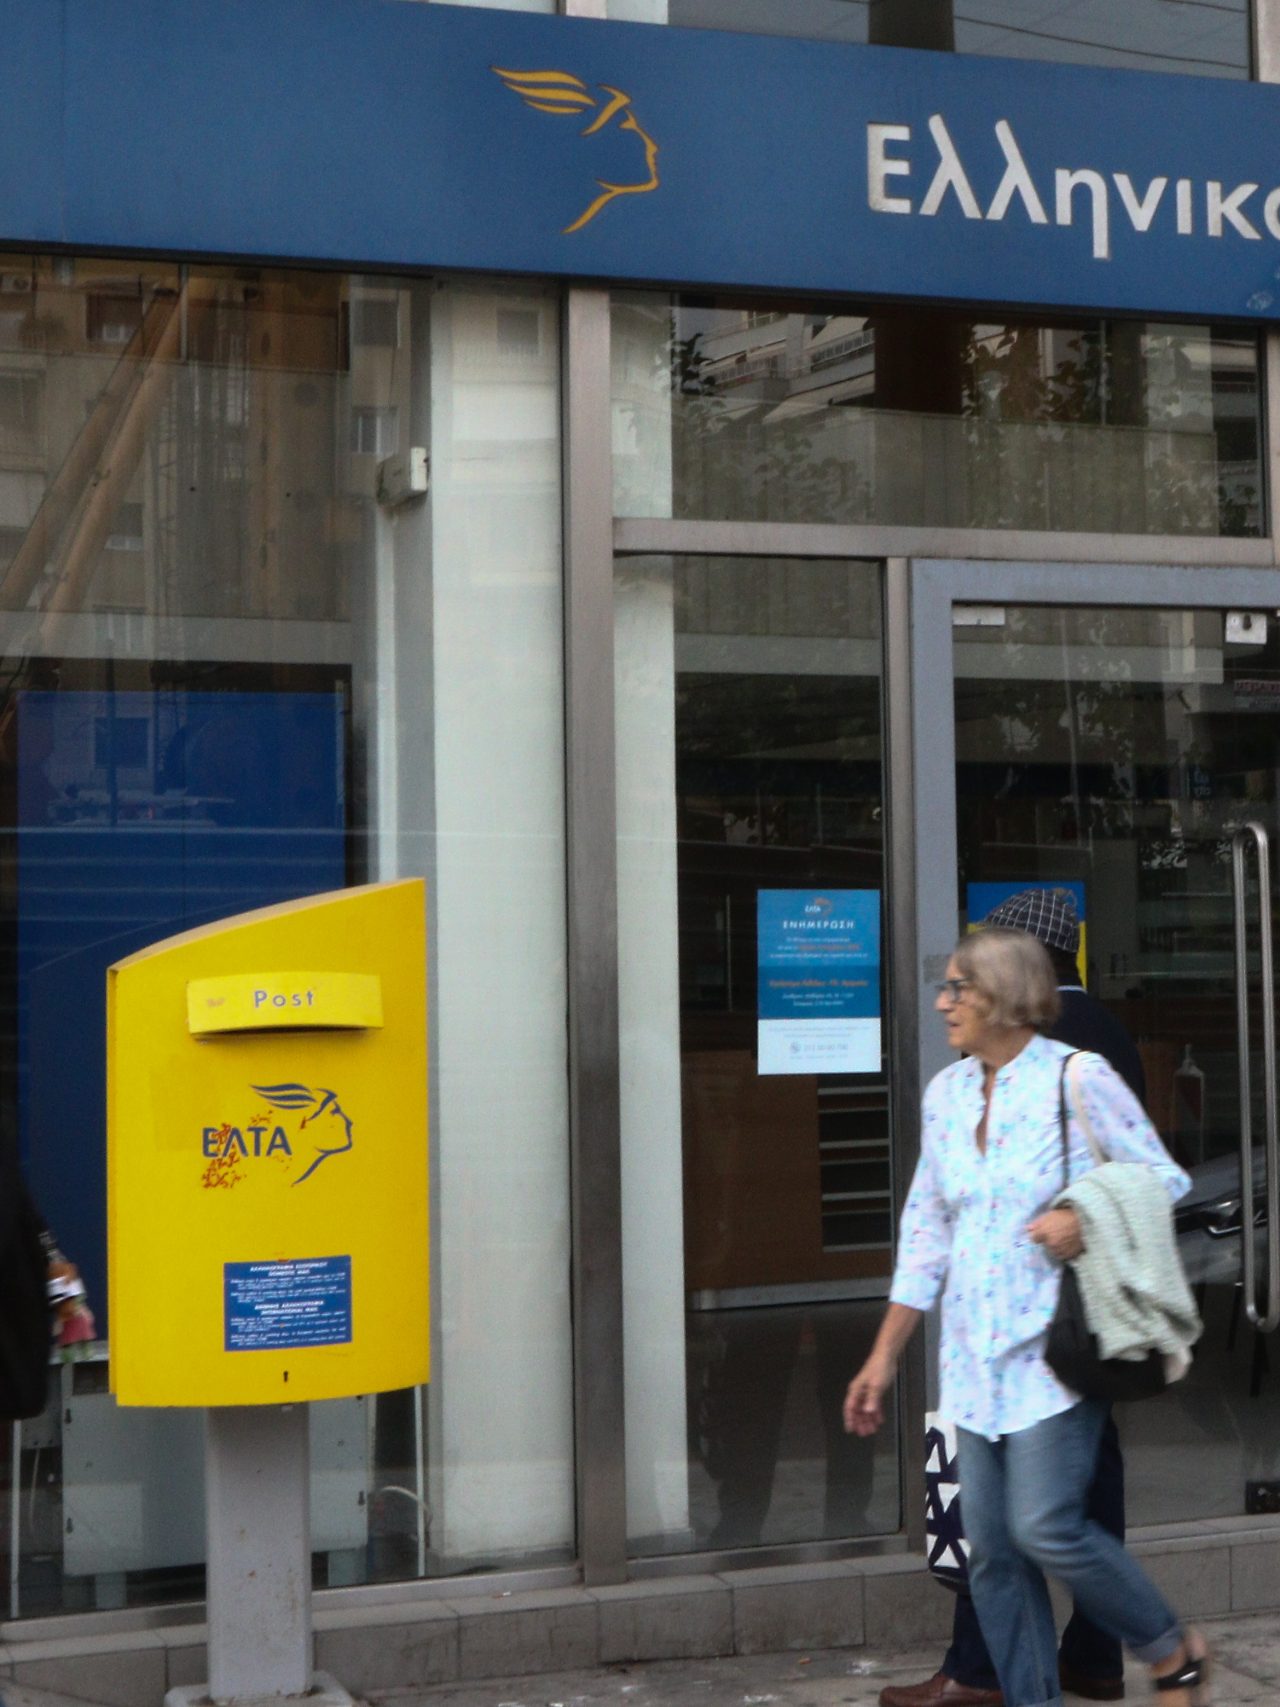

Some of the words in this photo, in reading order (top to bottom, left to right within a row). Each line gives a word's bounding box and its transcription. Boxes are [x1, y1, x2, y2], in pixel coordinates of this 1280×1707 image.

[783, 919, 856, 930] ΕΝΗΜΕΡΩΣΗ
[253, 990, 315, 1009] Post
[202, 1125, 293, 1158] ΕΛΤΑ
